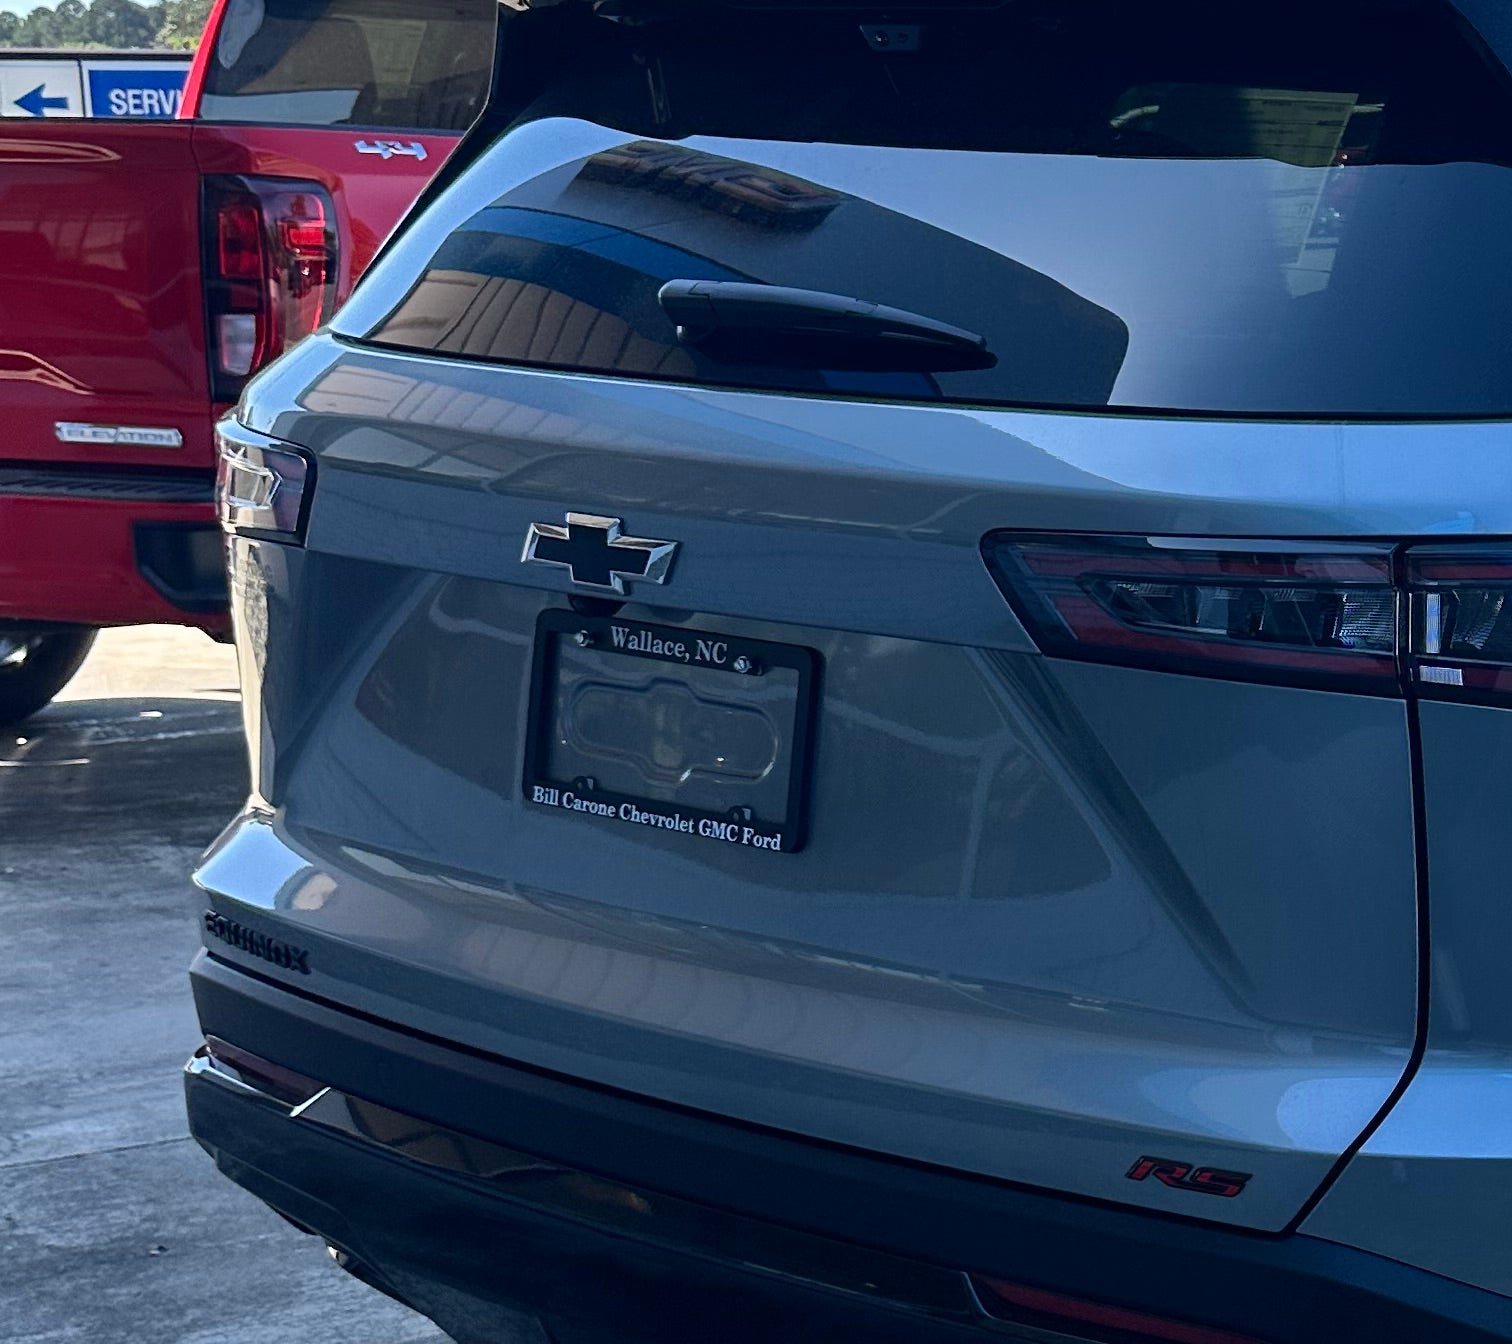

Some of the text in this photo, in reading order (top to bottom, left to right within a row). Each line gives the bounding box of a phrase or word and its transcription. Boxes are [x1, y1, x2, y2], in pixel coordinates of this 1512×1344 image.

[610, 625, 728, 664] Wallace, NC
[532, 785, 782, 851] Bill Carone Chevrolet GMC Ford
[1125, 1155, 1253, 1198] RS
